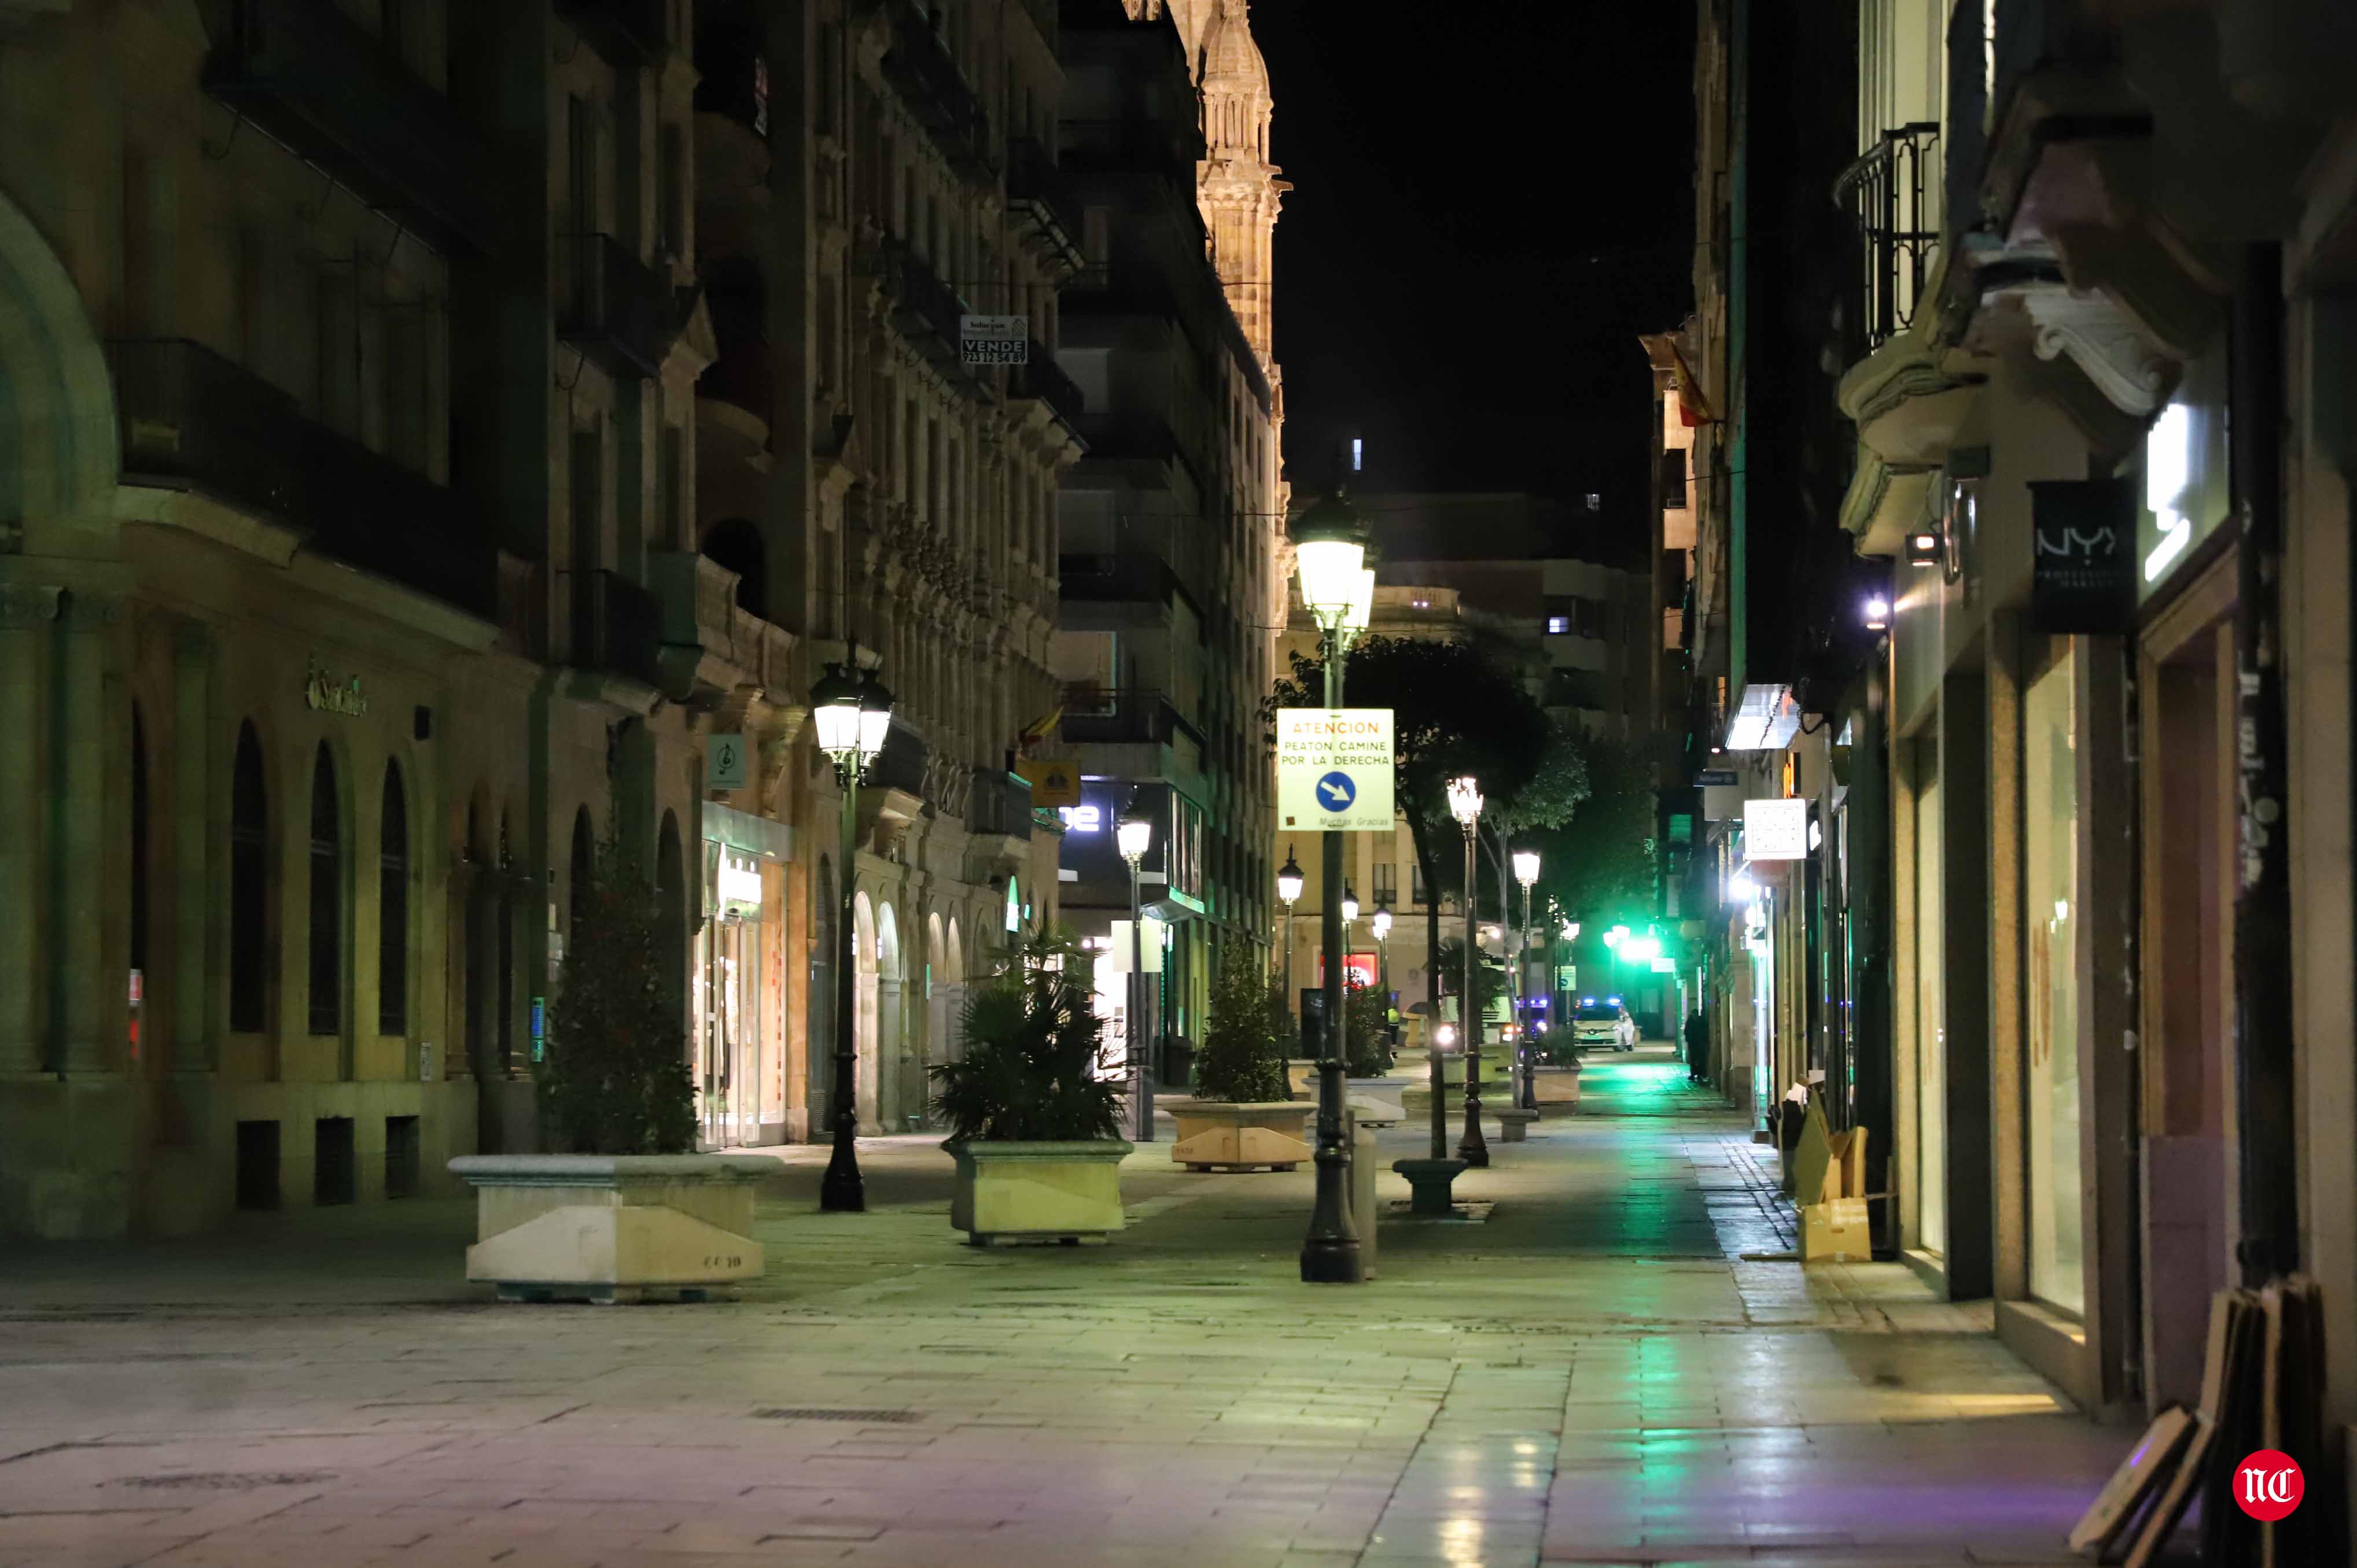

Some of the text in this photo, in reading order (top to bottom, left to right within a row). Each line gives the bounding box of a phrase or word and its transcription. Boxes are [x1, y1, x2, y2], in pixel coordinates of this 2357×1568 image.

[965, 340, 1023, 352] VENDE
[1293, 722, 1379, 734] ATENCION
[1285, 741, 1387, 751] PEATON CAMINE
[1282, 755, 1389, 765] POR LA DERECHA
[1319, 817, 1389, 826] Muchas Gracias
